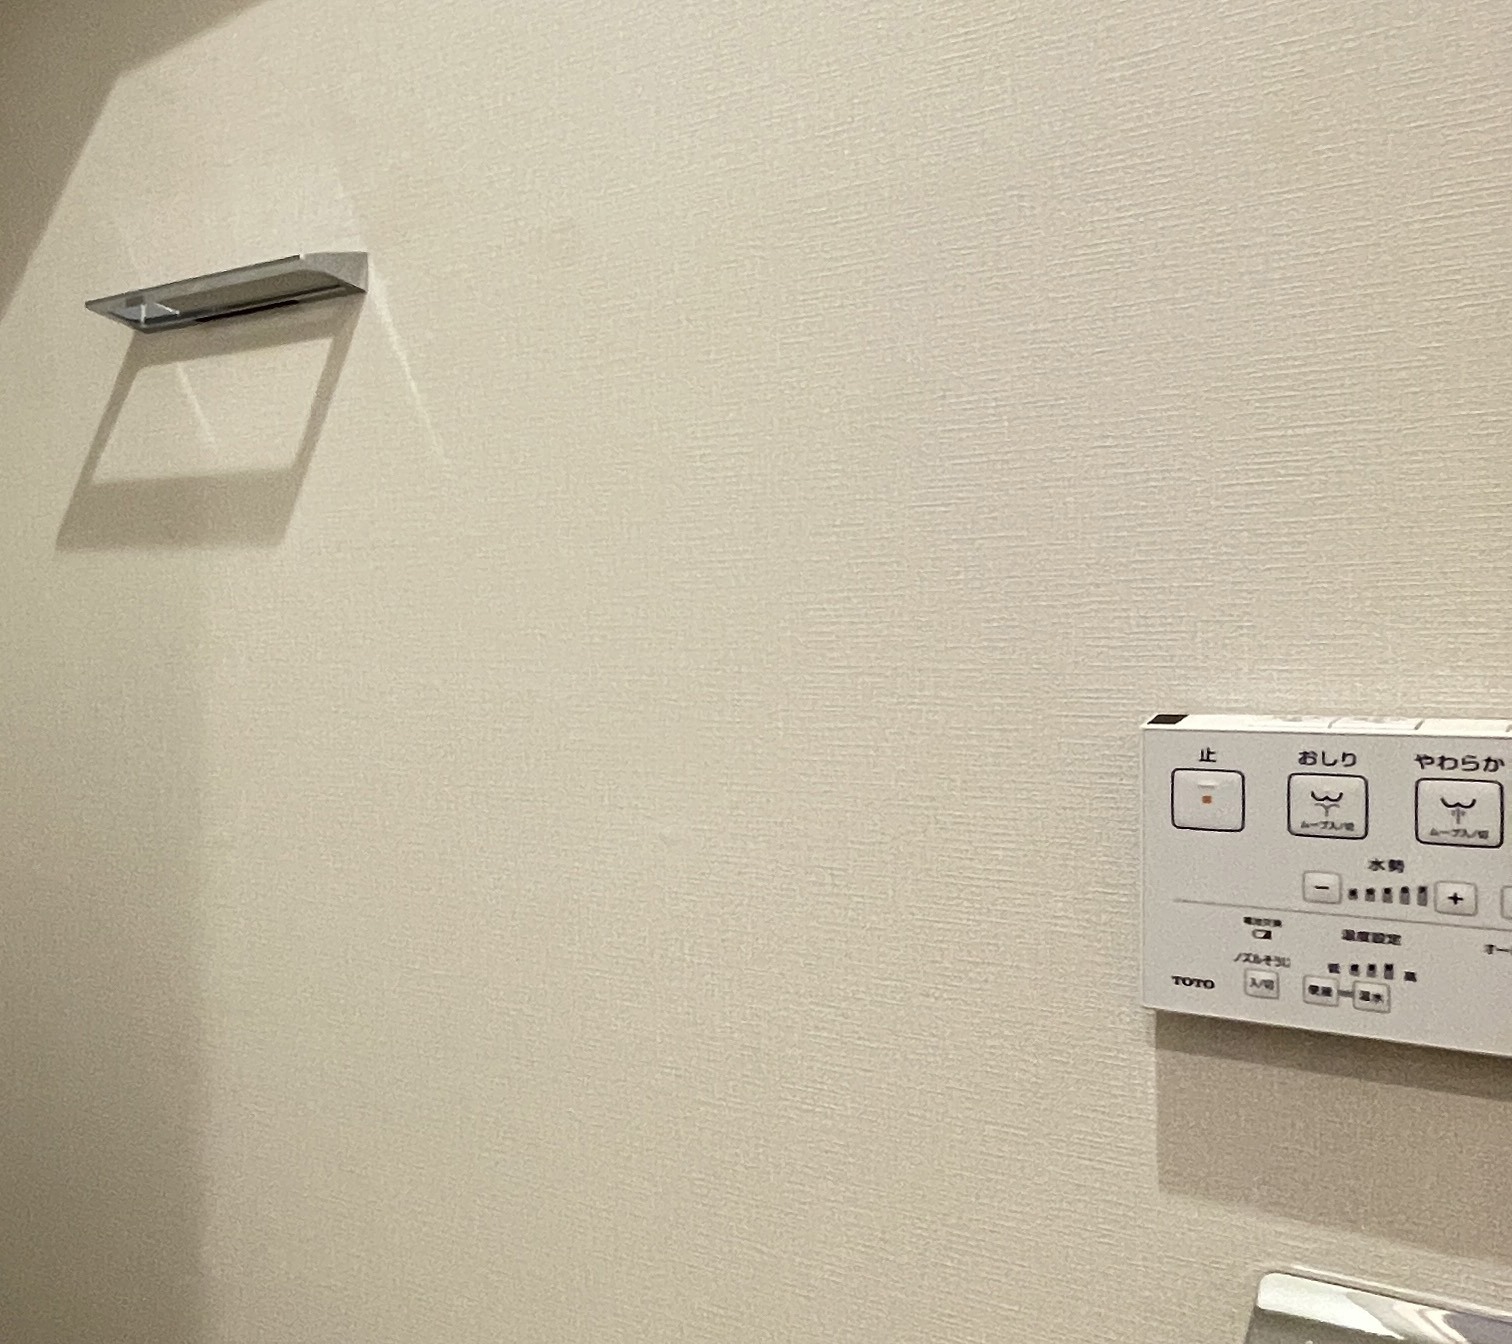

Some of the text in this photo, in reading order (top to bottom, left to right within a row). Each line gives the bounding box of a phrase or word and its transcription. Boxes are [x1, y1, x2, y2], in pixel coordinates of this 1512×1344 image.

[1199, 747, 1217, 763] 止
[1298, 750, 1358, 767] おしり
[1414, 754, 1505, 773] やわらか
[1171, 975, 1215, 990] TOTO
